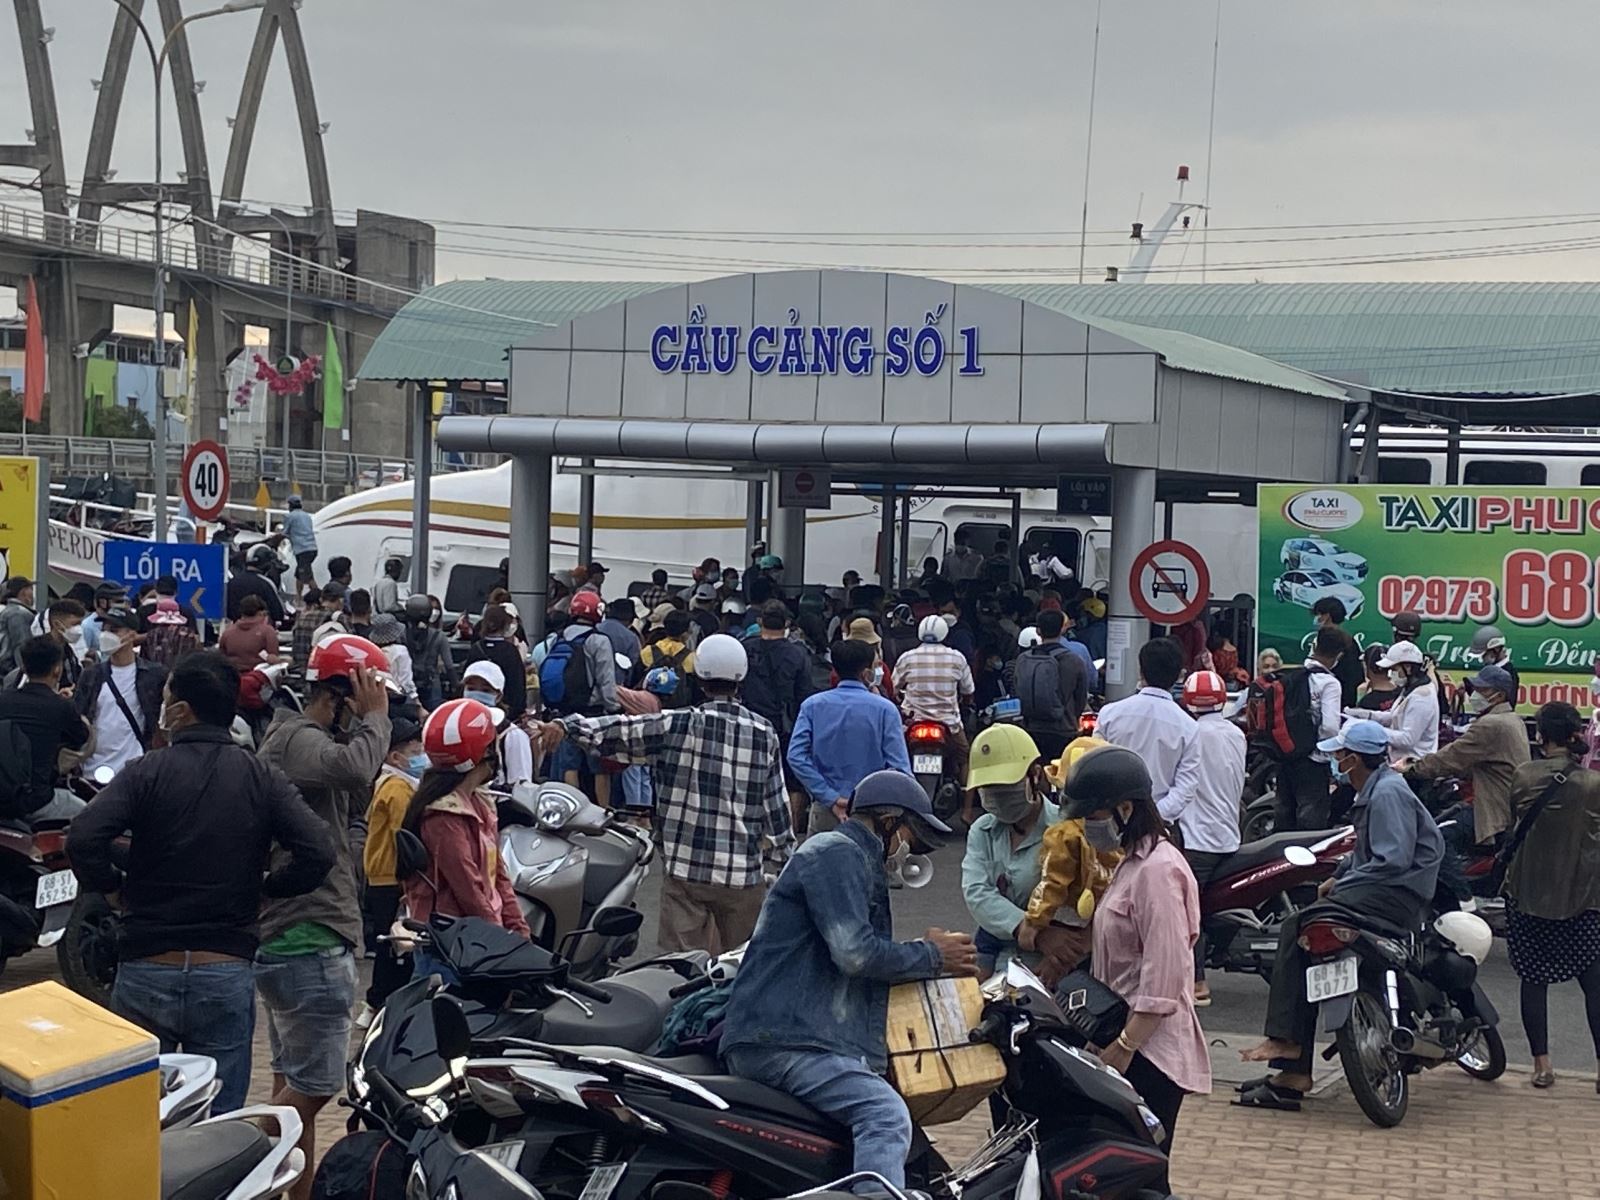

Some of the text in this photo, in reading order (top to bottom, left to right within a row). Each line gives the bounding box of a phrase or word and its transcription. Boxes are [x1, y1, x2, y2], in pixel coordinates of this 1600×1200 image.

[651, 303, 984, 376] CẦU CẢNG SỐ 1
[195, 462, 218, 497] 40
[1311, 497, 1339, 508] TAXI
[1377, 495, 1473, 531] TAXI
[124, 547, 202, 582] LỐI RA
[1379, 576, 1494, 619] 02973
[1314, 976, 1349, 998] 5077
